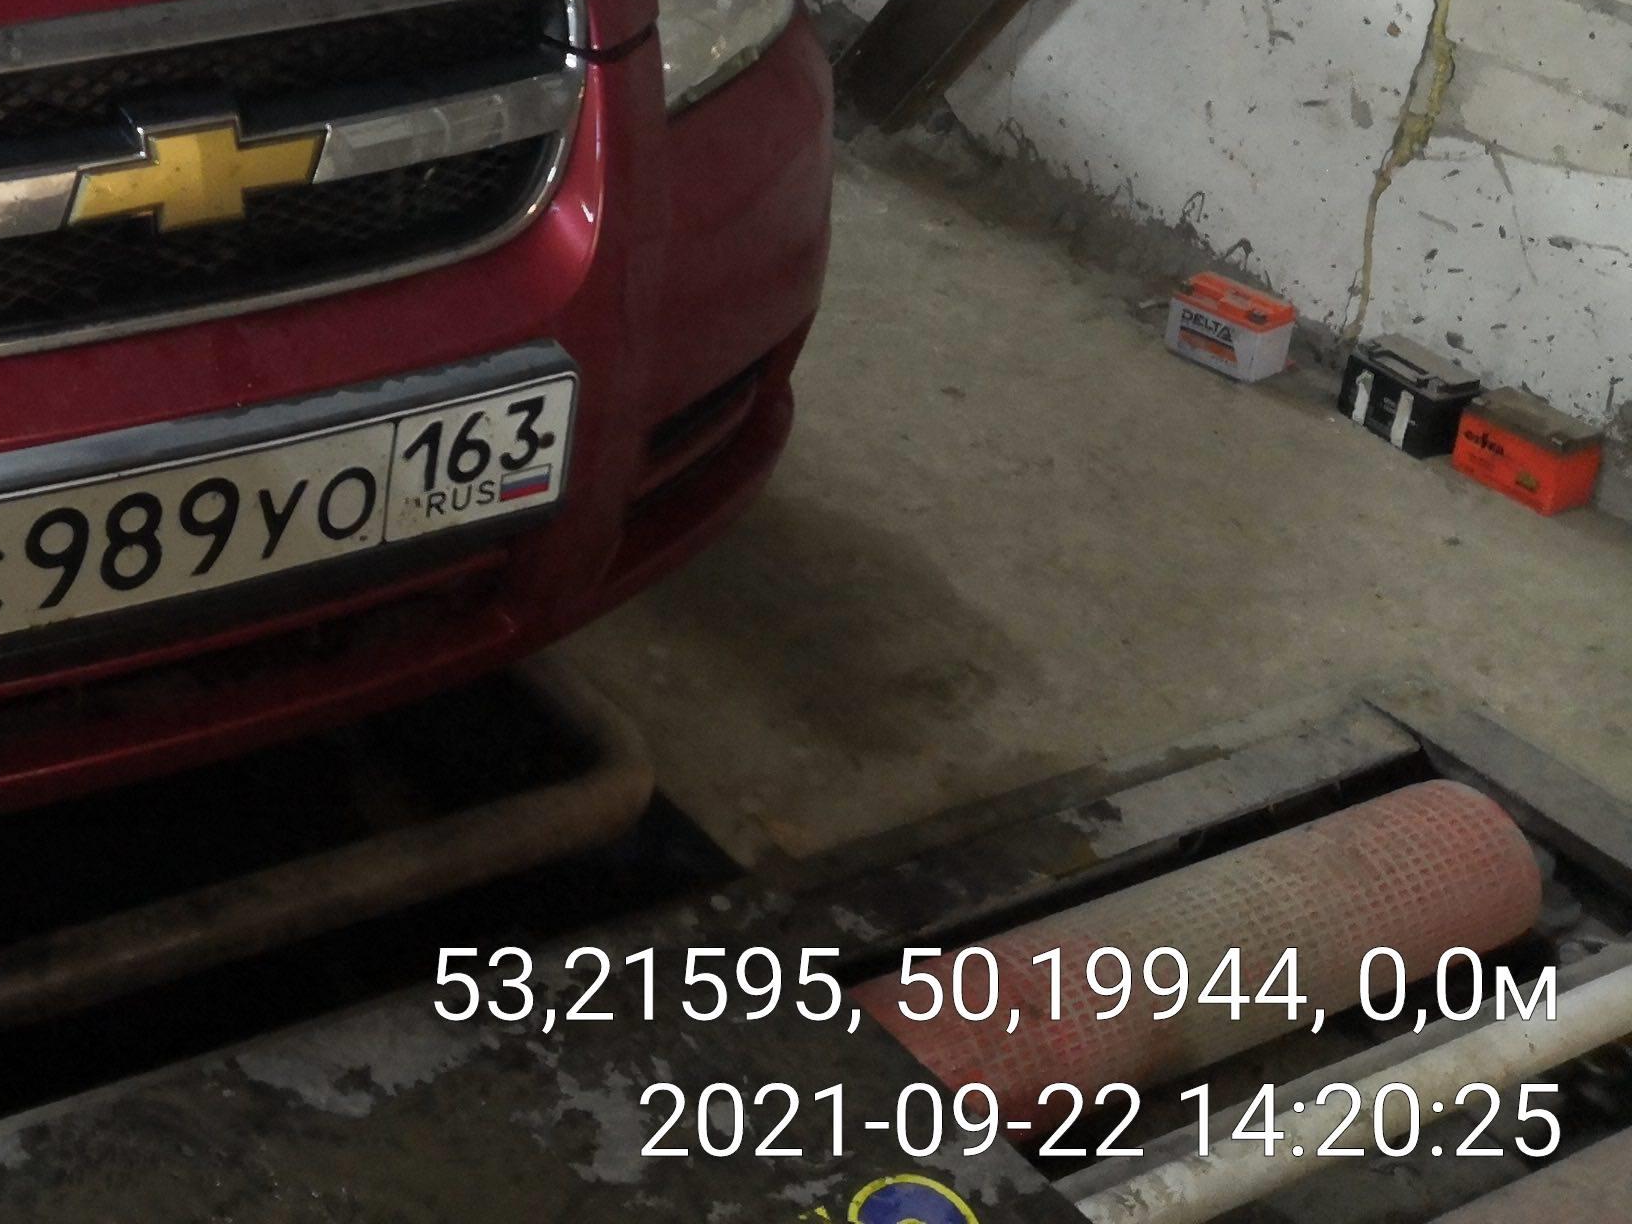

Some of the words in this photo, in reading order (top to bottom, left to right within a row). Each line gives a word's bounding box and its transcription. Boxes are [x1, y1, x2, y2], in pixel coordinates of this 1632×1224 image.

[1180, 308, 1234, 343] DELTA
[402, 395, 546, 493] 163
[425, 479, 496, 518] RUS
